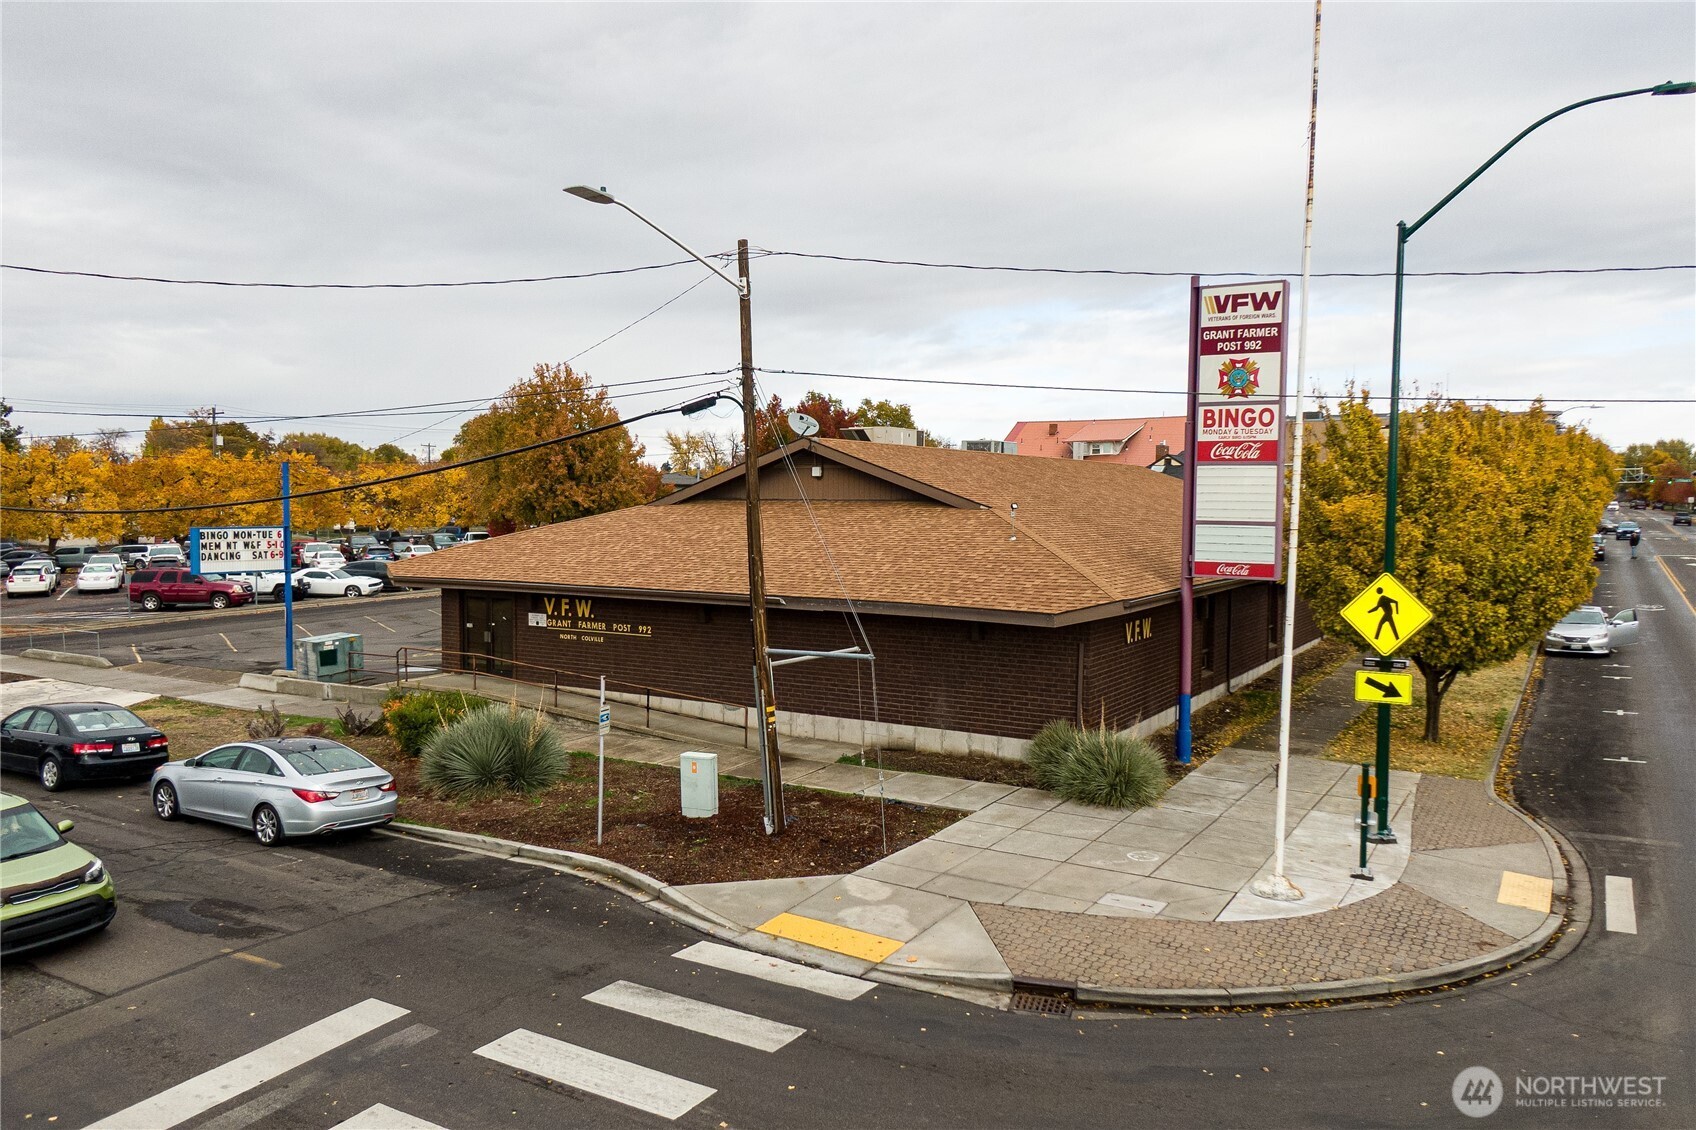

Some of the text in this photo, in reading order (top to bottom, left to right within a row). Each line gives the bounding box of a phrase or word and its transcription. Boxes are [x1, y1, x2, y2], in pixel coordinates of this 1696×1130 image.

[1213, 291, 1282, 314] VFW
[1203, 327, 1278, 341] GRANT FARMER
[1217, 340, 1262, 352] POST 992
[1203, 407, 1275, 428] BINGO
[200, 530, 282, 540] BINGO MON-TUE 6
[201, 541, 221, 551] MEM
[226, 541, 238, 550] NT
[243, 541, 261, 549] W&F
[201, 550, 284, 561] DANCING SAT 6-9
[544, 597, 595, 619] V.F.W.
[547, 618, 572, 628] GRANT
[578, 620, 606, 631] FARMER
[612, 623, 631, 633] POST
[638, 625, 652, 634] 992
[1125, 617, 1152, 644] V.F.W.
[581, 635, 604, 643] COLVILLE
